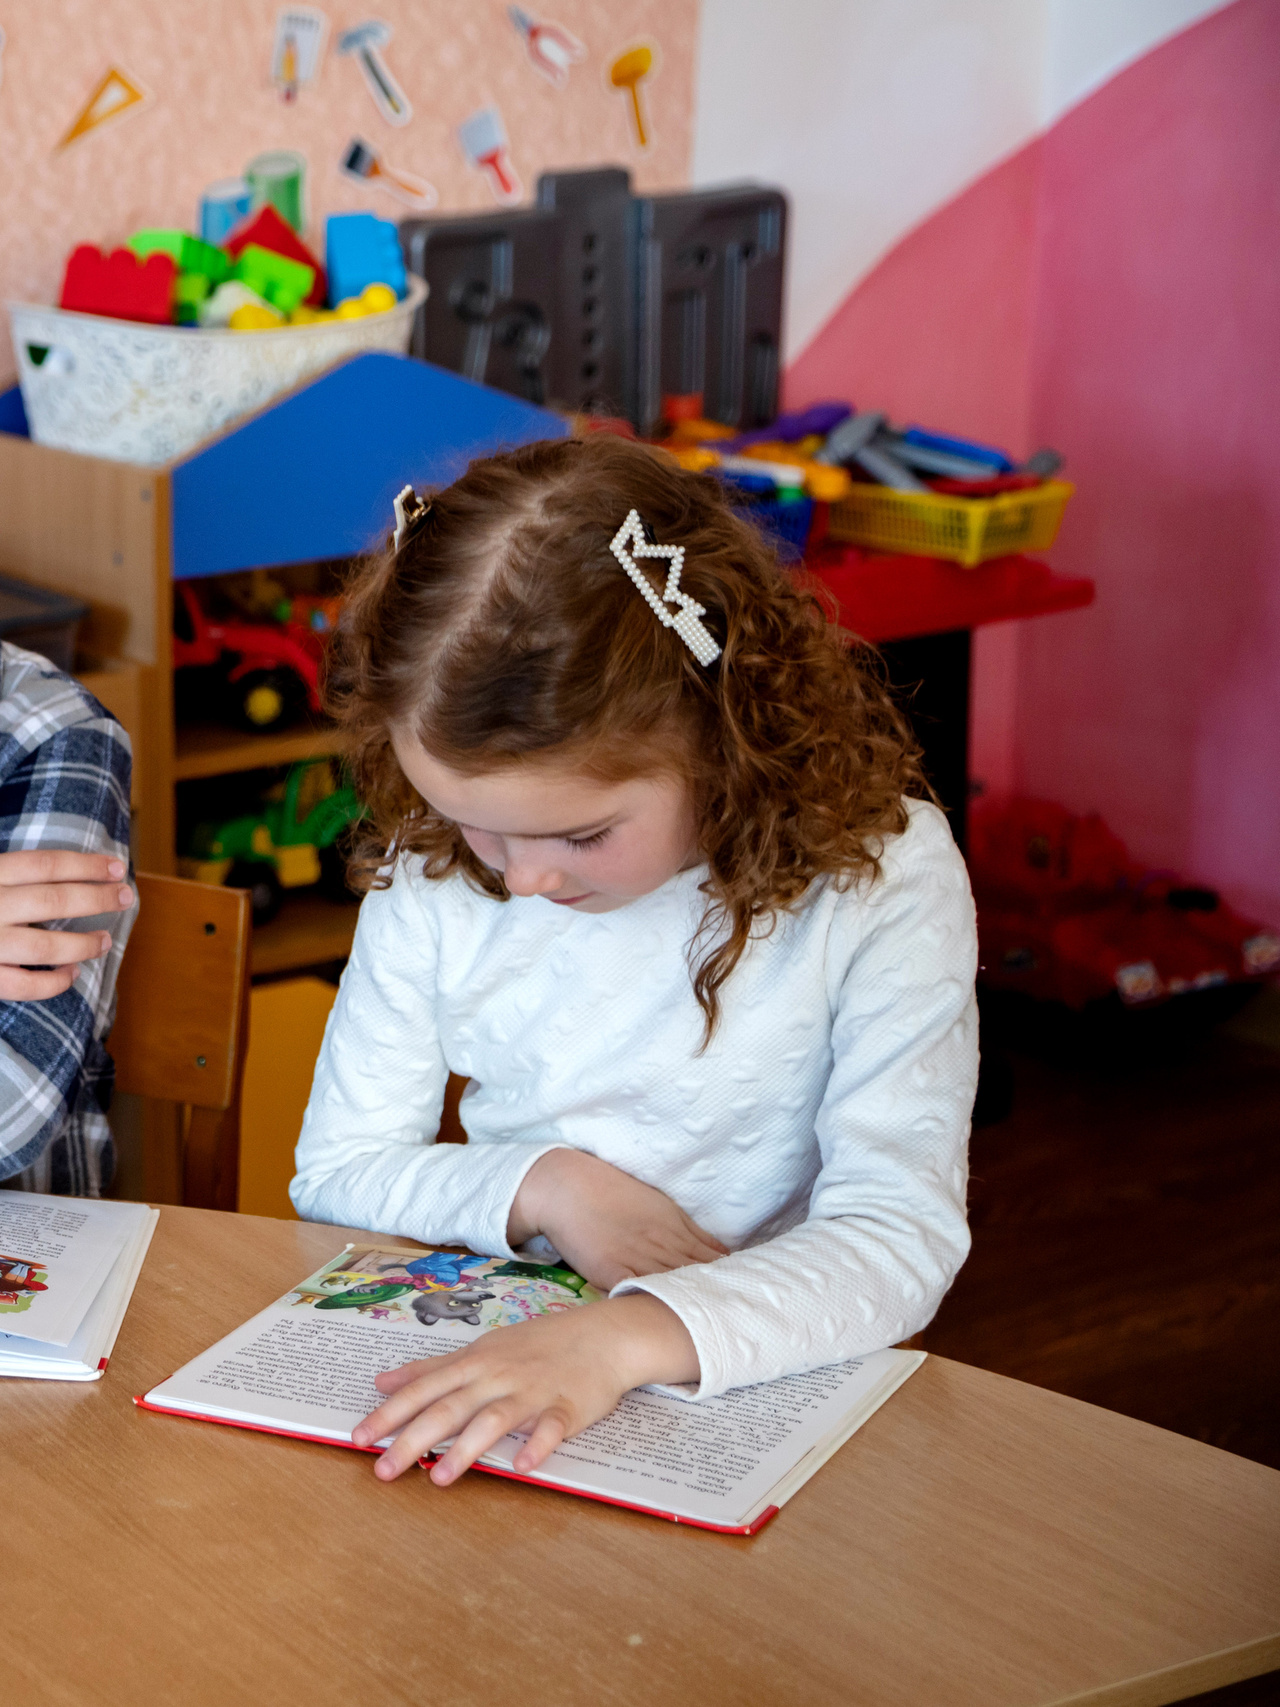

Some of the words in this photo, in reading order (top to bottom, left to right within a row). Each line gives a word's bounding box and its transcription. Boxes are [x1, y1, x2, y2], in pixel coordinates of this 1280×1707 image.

[327, 1326, 384, 1339] Настоящий
[374, 1340, 414, 1348] головой
[277, 1347, 338, 1361] беспомощно
[300, 1345, 346, 1356] смотрели
[333, 1345, 383, 1356] портретов
[391, 1348, 433, 1357] крытого
[222, 1359, 253, 1368] всегда
[342, 1358, 390, 1370] Волчонок
[257, 1366, 276, 1374] Как
[211, 1381, 240, 1390] будто
[257, 1378, 297, 1388] звонкое
[285, 1378, 334, 1390] Волчонка
[307, 1389, 377, 1403] разноцветное
[336, 1387, 364, 1395] через
[763, 1389, 796, 1398] вдруг
[748, 1397, 801, 1412] Волчонок
[732, 1411, 785, 1427] Волчонок
[761, 1412, 802, 1424] махнул
[583, 1431, 626, 1445] Открыл
[619, 1434, 656, 1445] водить
[623, 1429, 676, 1443] медленно
[659, 1443, 683, 1451] стал
[552, 1450, 610, 1467] надежност
[600, 1449, 646, 1462] толстую
[630, 1449, 694, 1468] называлась
[727, 1453, 760, 1464] снизу
[651, 1461, 692, 1474] старую
[721, 1458, 754, 1470] букву
[697, 1466, 742, 1480] которая
[698, 1473, 725, 1484] Взял
[658, 1476, 677, 1484] так
[684, 1482, 725, 1496] удобно,
